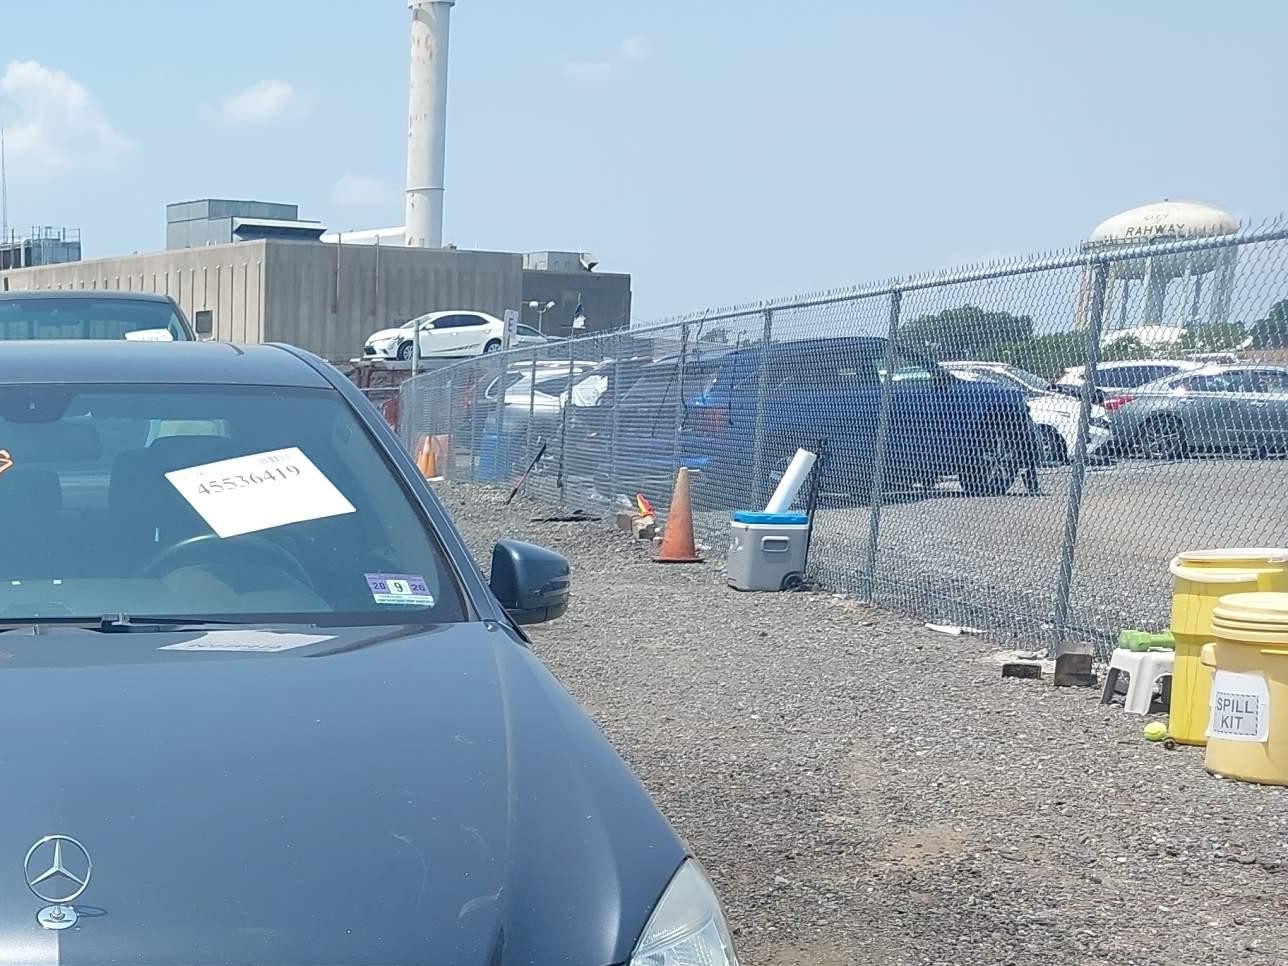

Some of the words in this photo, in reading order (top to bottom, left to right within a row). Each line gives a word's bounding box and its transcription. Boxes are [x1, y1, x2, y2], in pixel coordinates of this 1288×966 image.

[1125, 223, 1185, 236] RAHWAY
[198, 464, 301, 495] 45536419
[372, 582, 386, 590] 20
[394, 582, 404, 593] 9
[1216, 697, 1254, 714] SPILL
[1220, 716, 1243, 730] KIT
